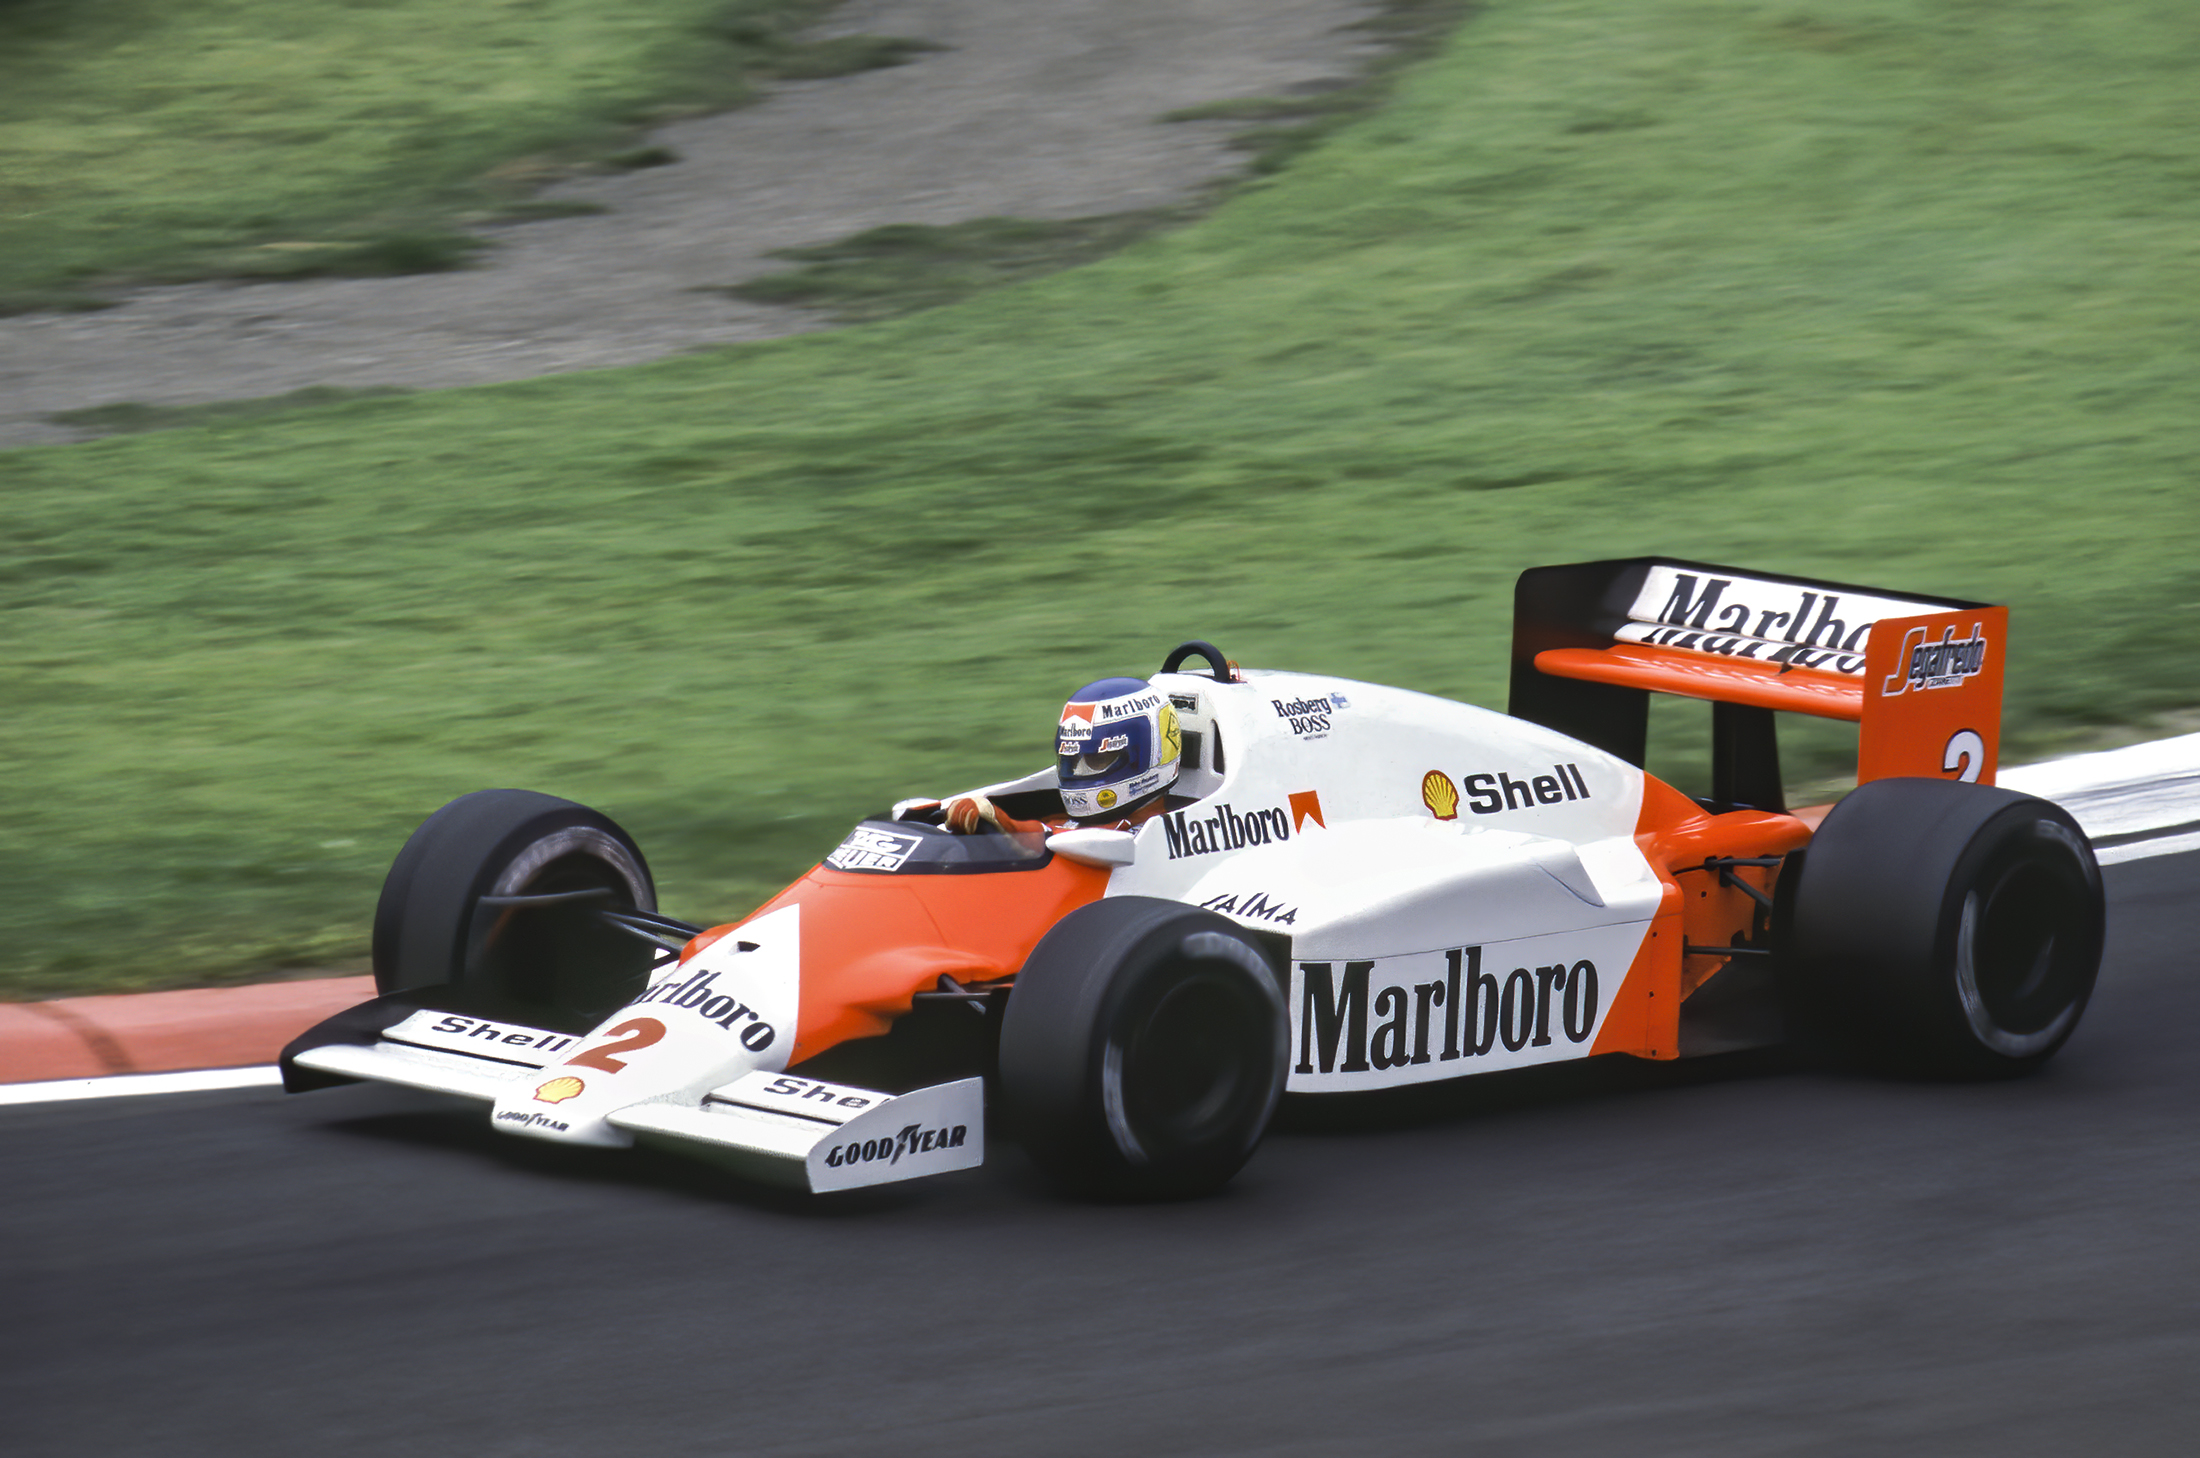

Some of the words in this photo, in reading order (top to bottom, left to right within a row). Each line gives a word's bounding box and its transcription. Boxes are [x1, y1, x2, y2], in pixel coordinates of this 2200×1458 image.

[1102, 694, 1161, 719] Marlboro
[1271, 697, 1332, 717] Rosberg
[1289, 714, 1331, 734] BOSS
[1943, 727, 1985, 784] 2
[1463, 763, 1591, 815] Shell
[1163, 804, 1290, 860] Marlboro
[1295, 945, 1599, 1075] Marlboro
[432, 1016, 572, 1052] Shell
[562, 1016, 668, 1075] 2
[764, 1077, 890, 1109] She
[497, 1111, 570, 1132] GOODYEAR
[824, 1123, 967, 1170] GOODYEAR
